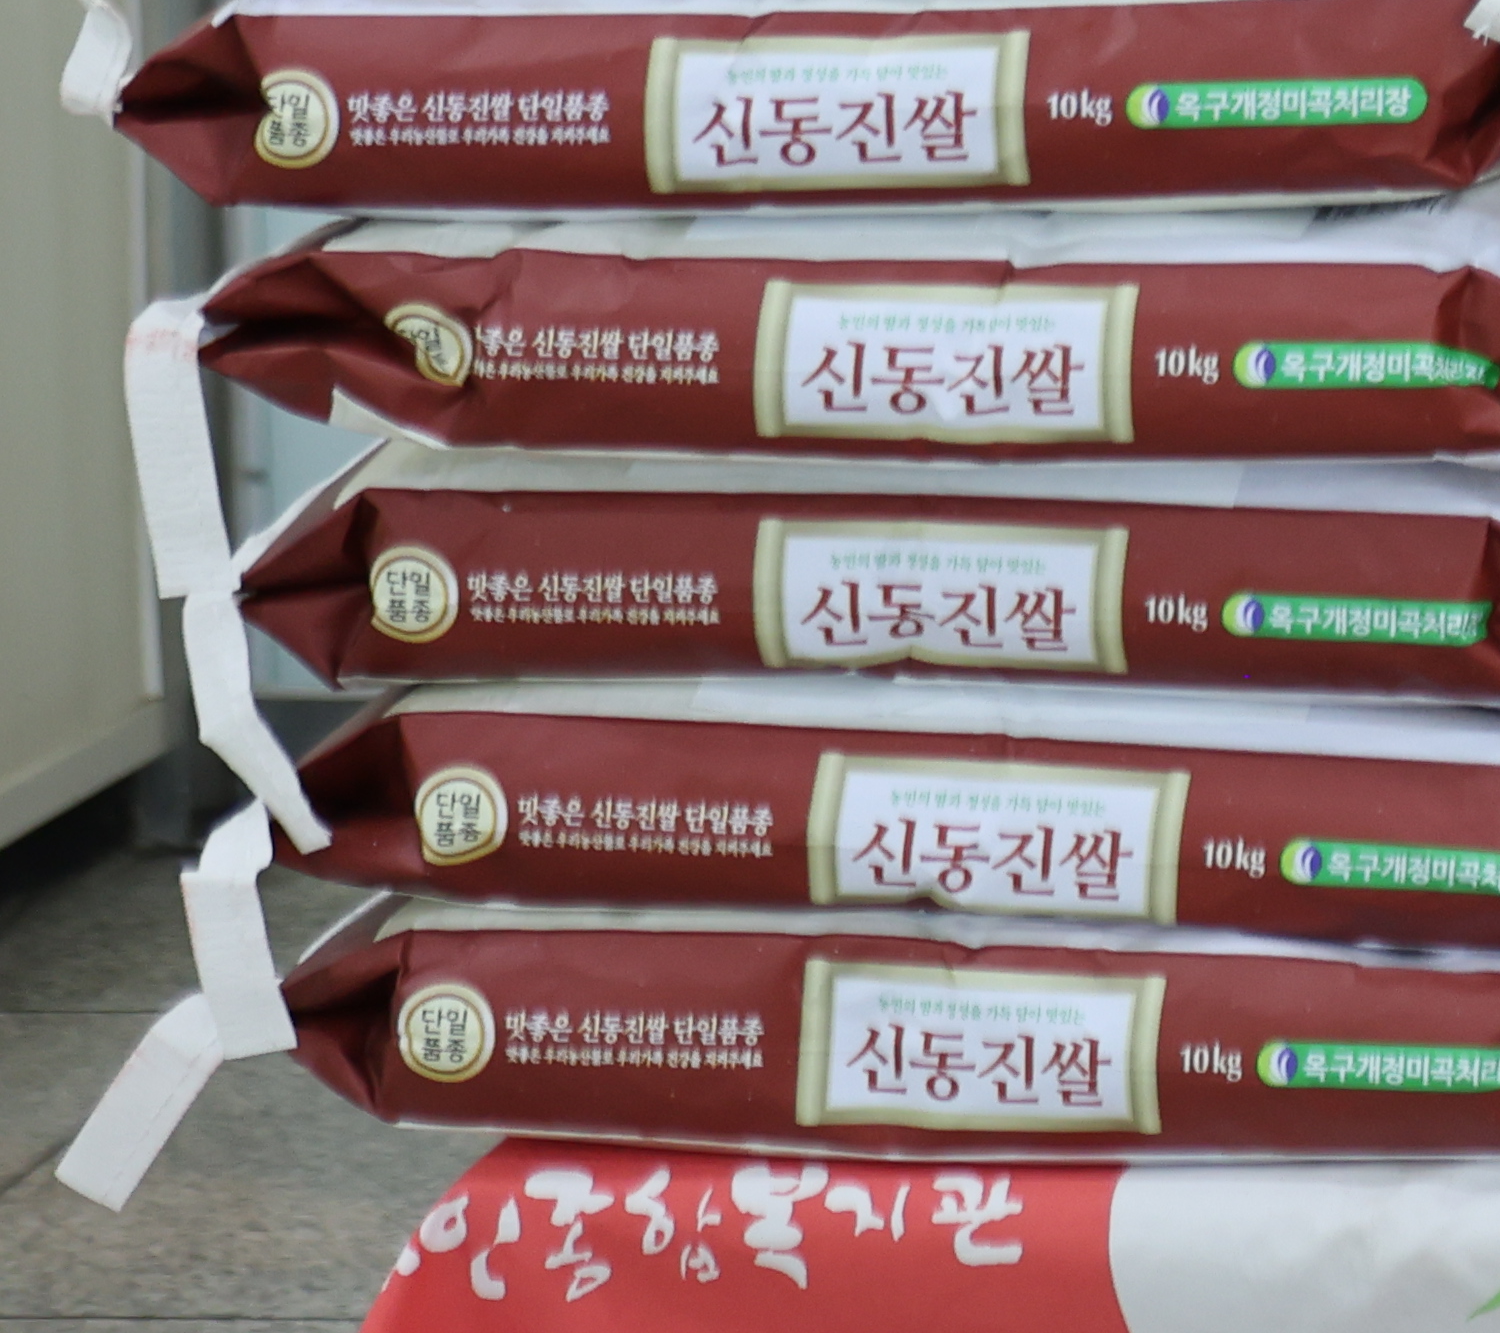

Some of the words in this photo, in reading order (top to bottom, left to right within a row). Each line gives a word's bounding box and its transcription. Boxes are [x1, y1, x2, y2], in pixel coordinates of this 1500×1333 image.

[348, 93, 416, 123] 맛좋은
[422, 92, 513, 122] 신동진쌀
[518, 91, 608, 122] 단일품종
[1047, 89, 1111, 125] 10kg
[1176, 85, 1411, 120] 옥구개정미곡처리장
[695, 92, 976, 167] 신동진쌀
[532, 327, 624, 359] 신동진쌀
[628, 329, 718, 362] 단일품종
[803, 343, 1083, 416] 신동진쌀
[1156, 346, 1218, 384] 10kg
[467, 572, 532, 602] 맛좋은
[539, 573, 625, 602] 신동진쌀
[630, 573, 717, 604] 단일품종
[803, 582, 1075, 651] 신동진쌀
[1146, 594, 1207, 630] 10kg
[437, 792, 482, 820] 단일
[518, 795, 584, 826] 맛좋은
[591, 799, 681, 831] 신동진쌀
[685, 802, 773, 836] 단일품종
[852, 820, 1132, 900] 신동진쌀
[1204, 838, 1265, 877] 10kg
[422, 1009, 470, 1036] 단일
[506, 1012, 572, 1046] 맛좋은
[579, 1013, 669, 1044] 신동진쌀
[674, 1014, 764, 1046] 단일품종
[849, 1024, 1110, 1107] 신동진쌀
[1181, 1042, 1242, 1081] 10kg
[384, 1166, 1023, 1301] 인종합복지관
